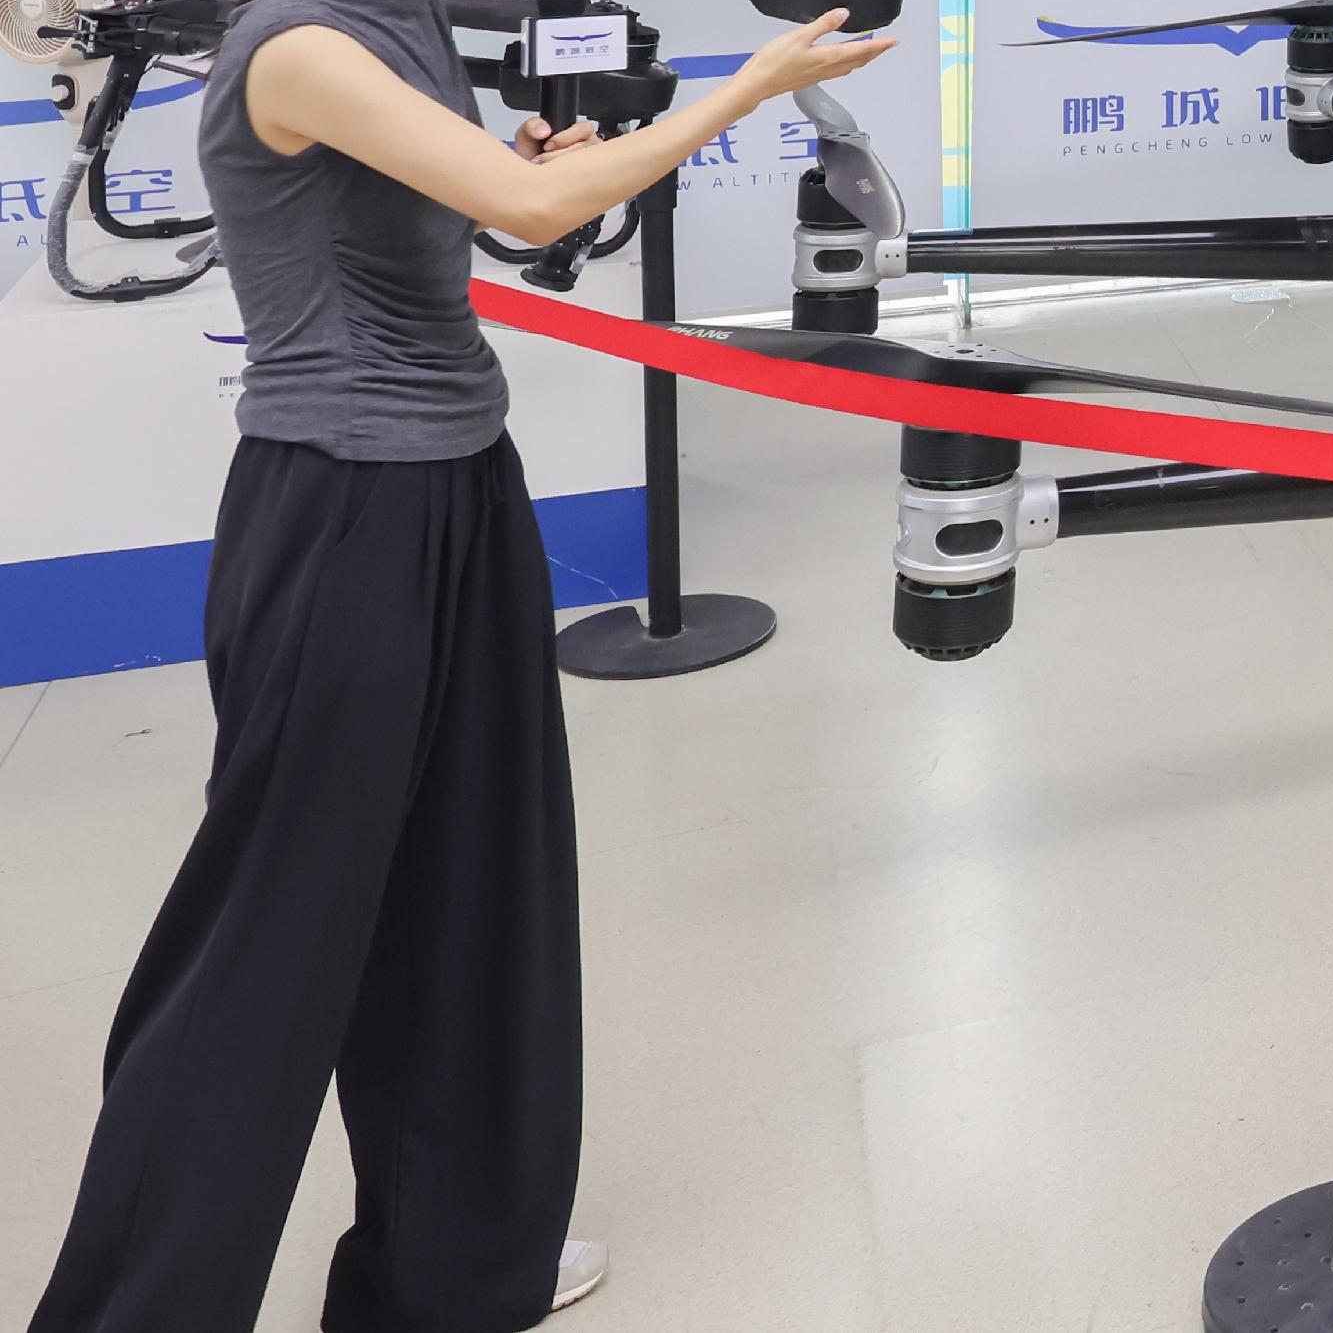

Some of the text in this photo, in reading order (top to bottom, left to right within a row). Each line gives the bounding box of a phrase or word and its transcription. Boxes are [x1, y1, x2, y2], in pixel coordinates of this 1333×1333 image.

[1062, 132, 1274, 157] PENGCHENG LOW
[712, 171, 802, 189] ALTIT
